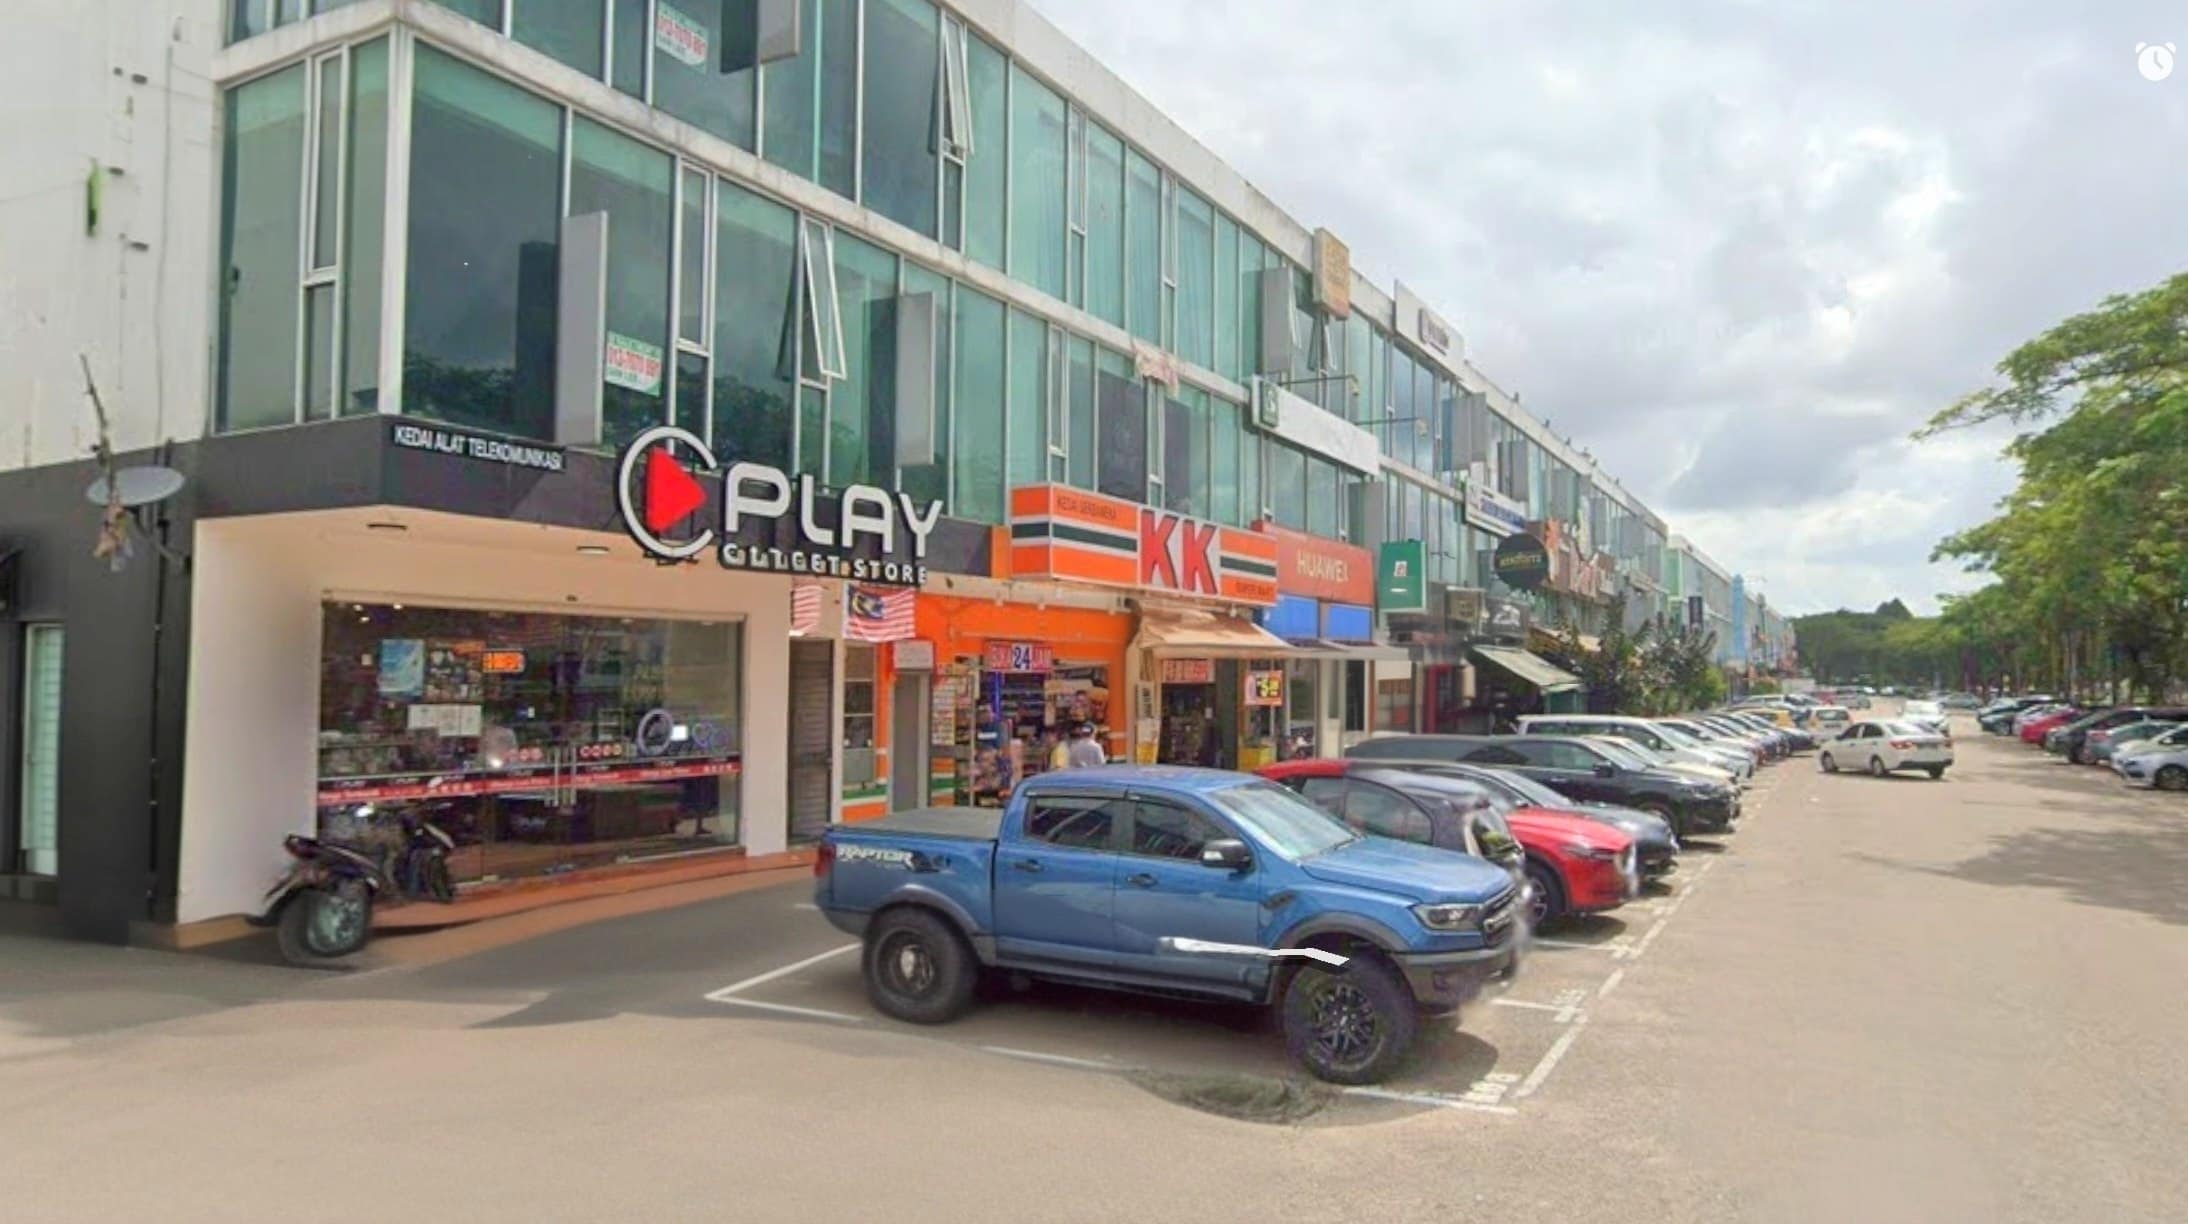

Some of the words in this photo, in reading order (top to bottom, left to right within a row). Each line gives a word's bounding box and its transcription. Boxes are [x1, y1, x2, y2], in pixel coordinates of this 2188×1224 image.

[394, 424, 433, 449] KEDAI
[434, 431, 466, 455] ALAT
[724, 462, 943, 558] PLAY
[1140, 508, 1218, 595] KK
[1296, 549, 1349, 583] HUAWEI
[853, 558, 928, 585] STORE
[1013, 645, 1030, 670] 24
